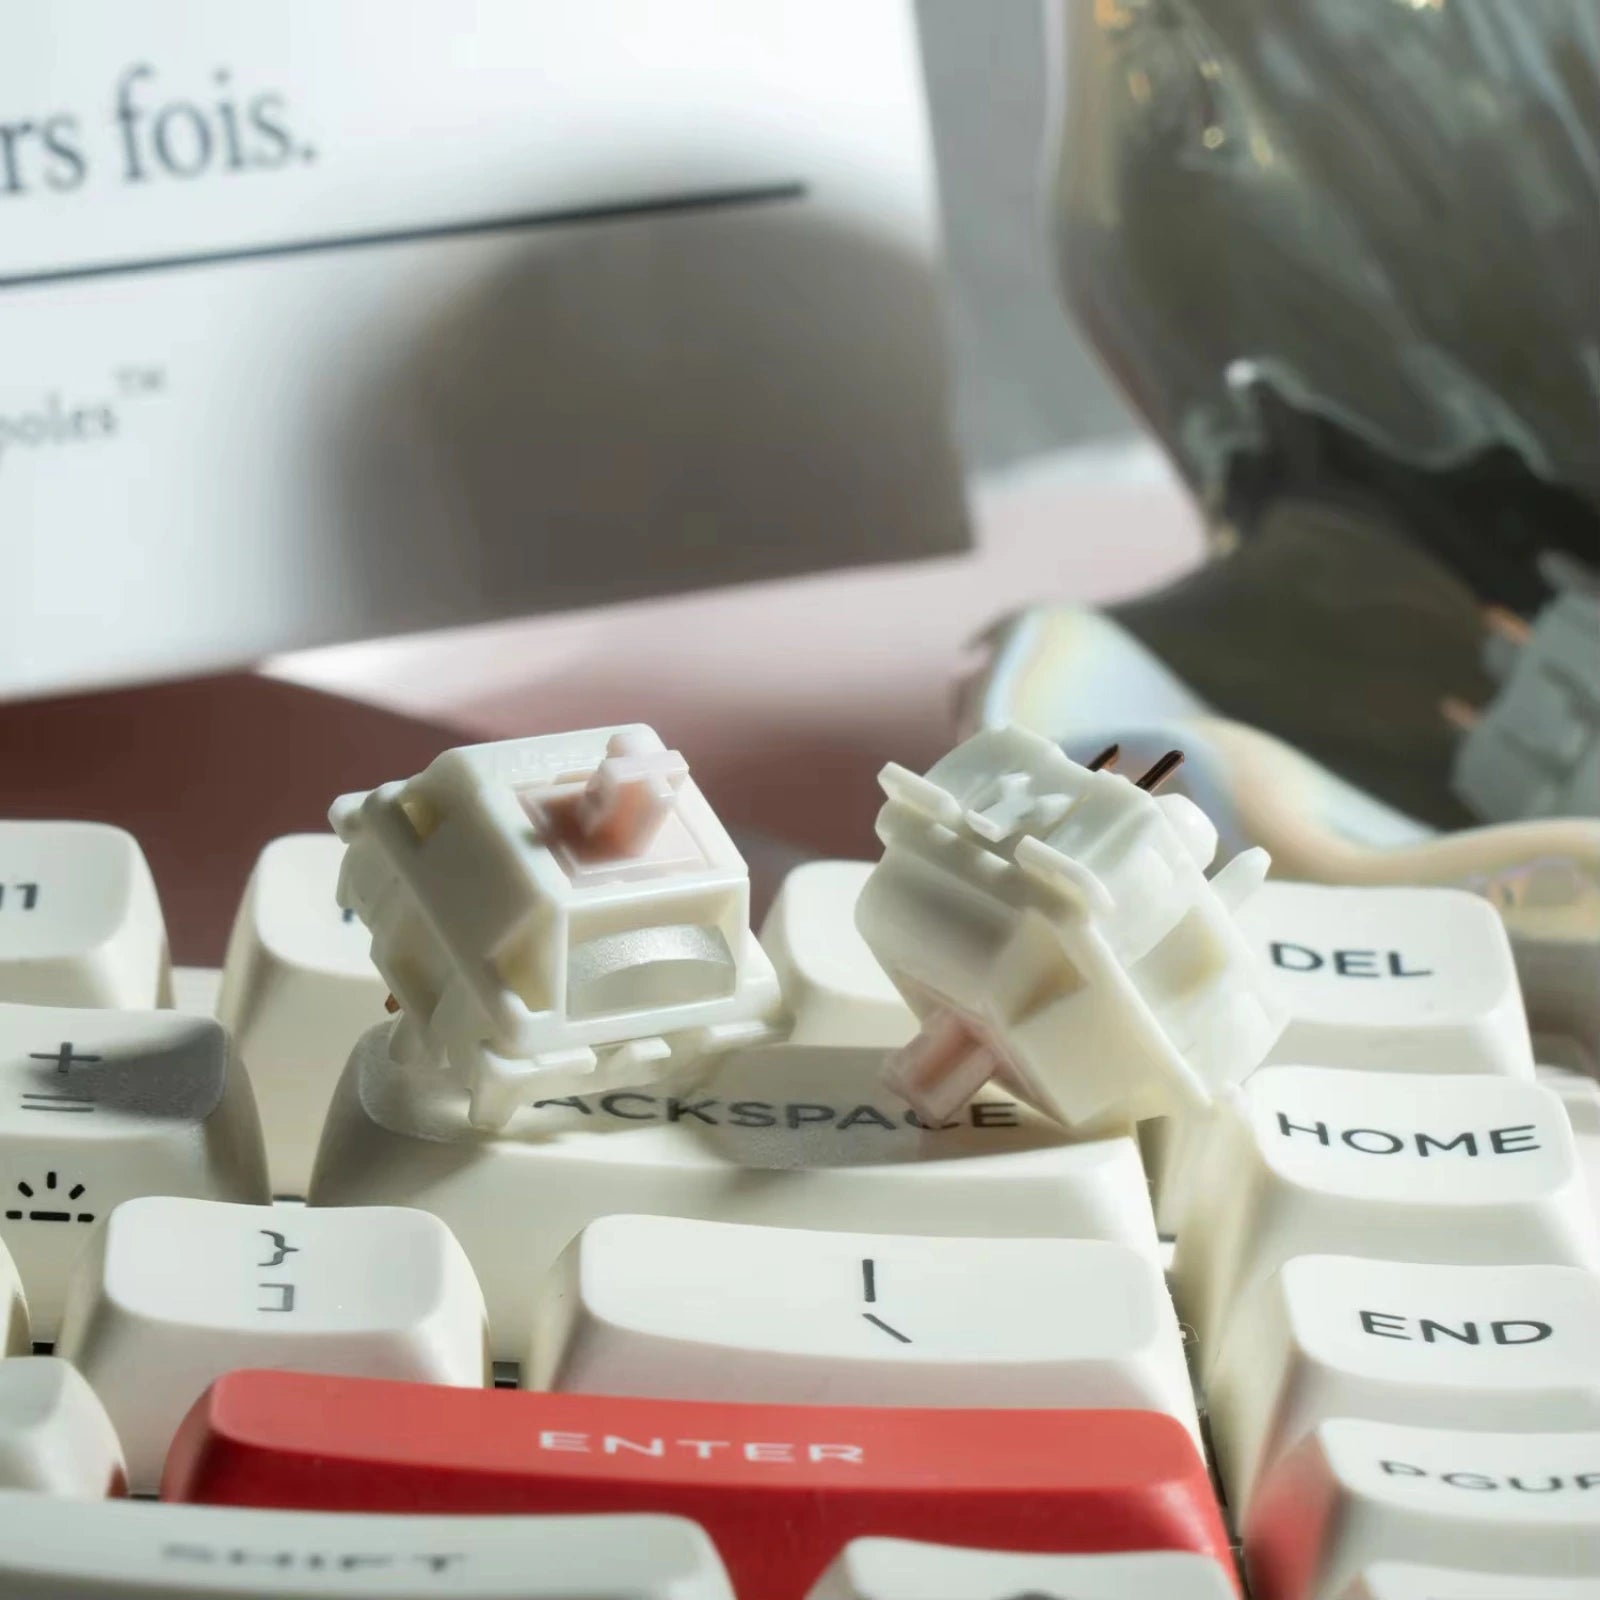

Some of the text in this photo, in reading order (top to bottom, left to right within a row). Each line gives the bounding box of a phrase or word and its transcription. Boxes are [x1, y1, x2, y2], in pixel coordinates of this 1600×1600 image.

[0, 63, 316, 195] rs fois.
[1269, 941, 1432, 978] DEL
[1277, 1112, 1541, 1157] HOME
[1359, 1310, 1553, 1345] END
[538, 1430, 864, 1463] ENTER
